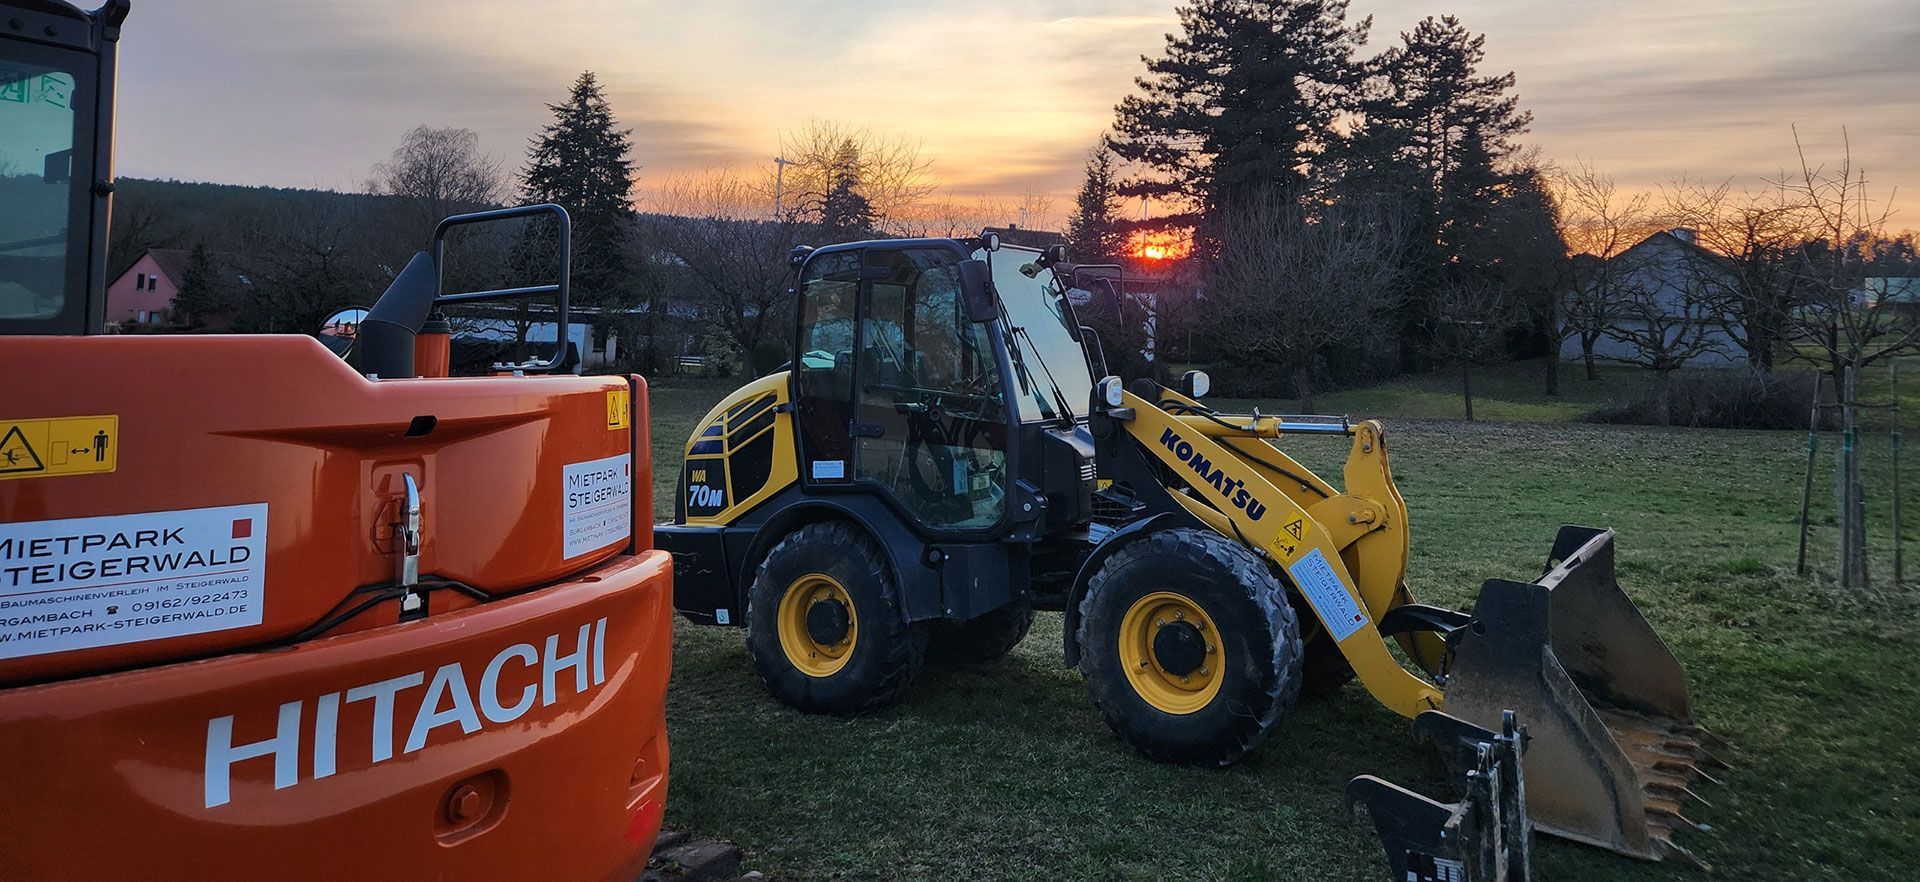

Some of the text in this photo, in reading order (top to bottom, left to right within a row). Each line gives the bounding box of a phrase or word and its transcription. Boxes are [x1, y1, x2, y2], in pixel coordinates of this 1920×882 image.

[569, 468, 618, 490] MIETPARK
[691, 469, 707, 483] WA
[1159, 427, 1267, 521] KOMATSU
[569, 481, 629, 509] STEIGERWALD
[688, 484, 723, 507] 70M
[0, 546, 251, 587] TEIGERWALD
[1312, 553, 1349, 605] MIETPARK
[0, 576, 249, 609] BAUMASCHINENVERLEIH IM STEIGERWALD
[131, 589, 248, 612] 09162/922473
[1306, 558, 1356, 627] STEIGERWALD
[204, 616, 608, 809] HITACHI
